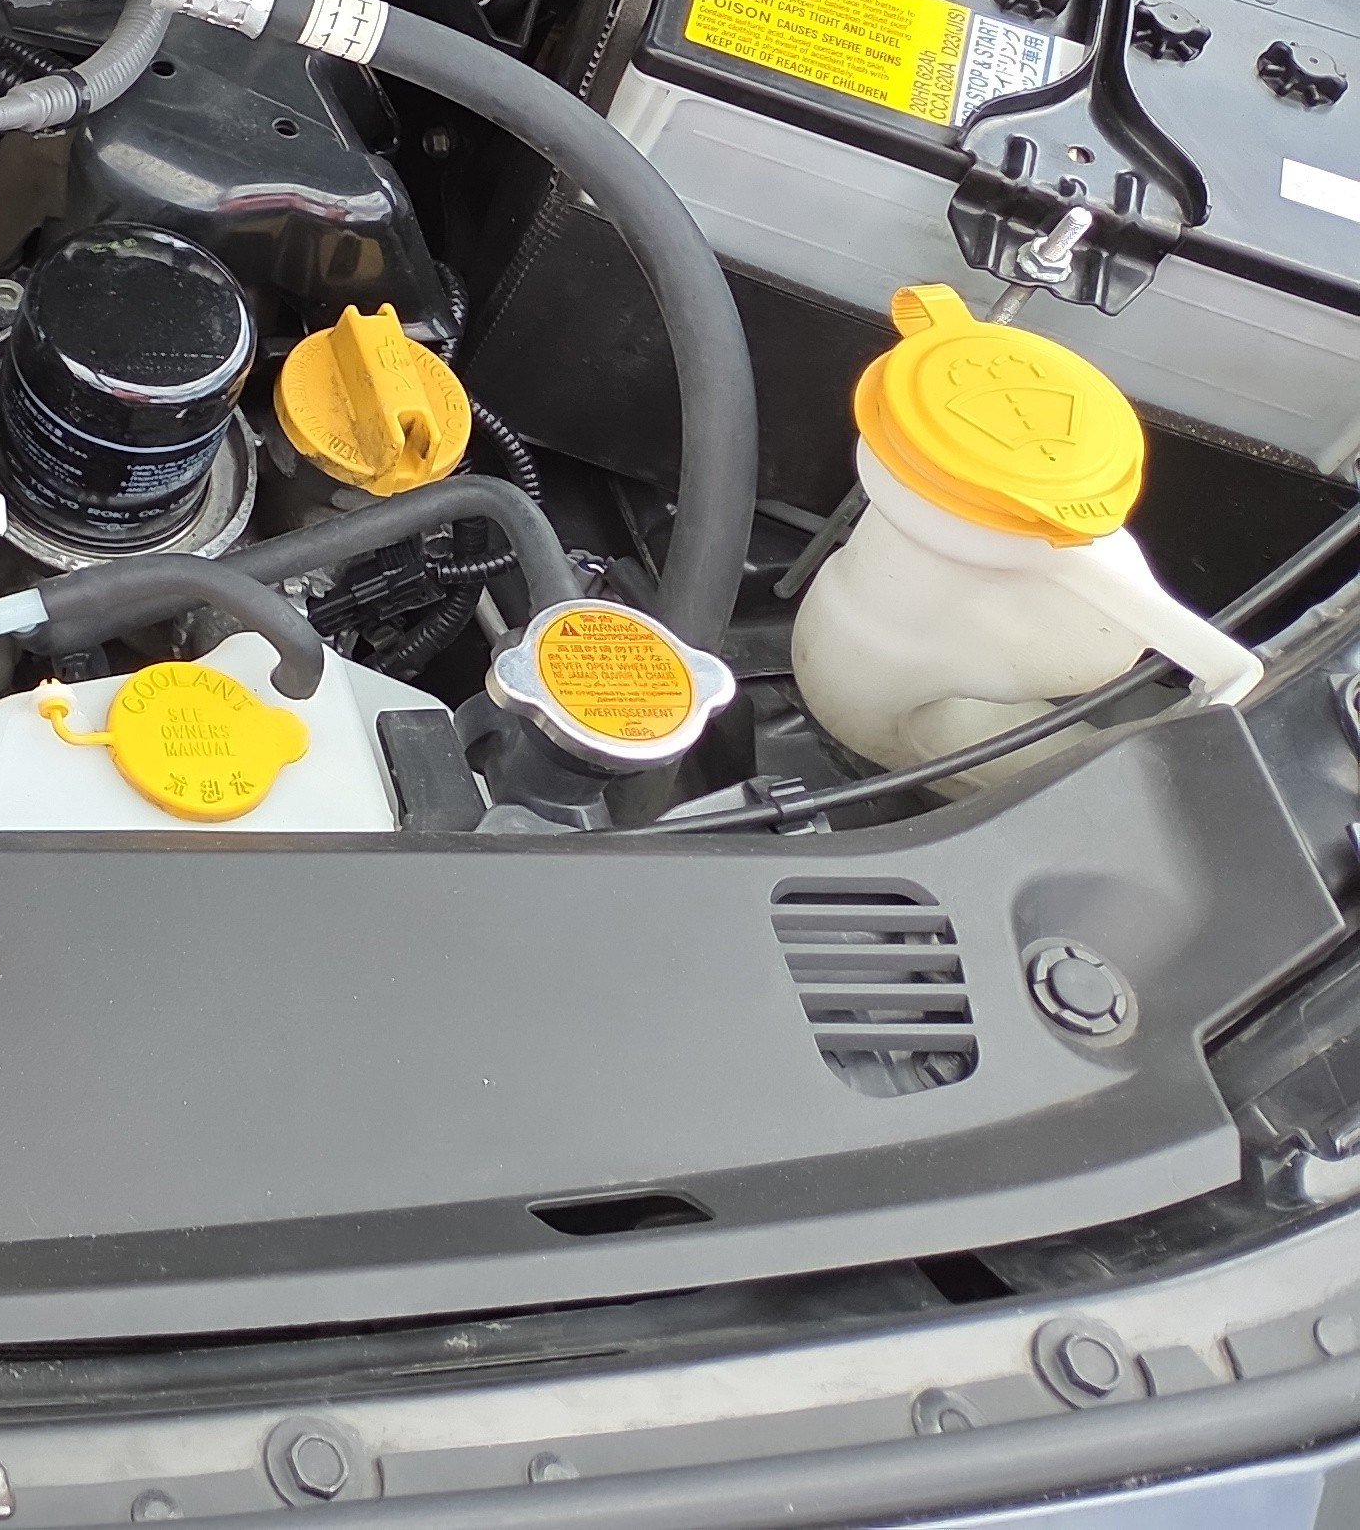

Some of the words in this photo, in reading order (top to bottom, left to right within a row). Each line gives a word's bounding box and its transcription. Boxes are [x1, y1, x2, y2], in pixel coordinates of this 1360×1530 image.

[777, 0, 805, 17] CAPS
[807, 10, 840, 29] TIGHT
[843, 22, 865, 37] AND
[868, 30, 901, 49] LEVEL
[974, 19, 999, 59] START
[776, 17, 818, 39] CAUSES
[821, 32, 861, 54] SEVERE
[865, 47, 902, 67] BURNS
[705, 32, 732, 49] KEEP
[734, 42, 756, 57] OUT
[758, 50, 772, 63] OF
[775, 56, 811, 76] REACH
[815, 70, 828, 82] OF
[831, 75, 887, 102] CHILDREN
[915, 50, 937, 81] 62Ah
[935, 62, 956, 92] 620A
[909, 80, 933, 115] 20HR
[965, 68, 990, 102] STOP
[929, 93, 951, 120] CCA
[30, 475, 80, 510] TOKYO
[87, 507, 130, 519] ROKI
[1055, 500, 1118, 520] PULL
[580, 623, 638, 633] WARNING
[550, 662, 582, 671] NEVER
[586, 663, 613, 671] OPEN
[618, 663, 647, 671] WHEN
[121, 667, 253, 714] COOLANT
[167, 707, 204, 723] SEE
[584, 708, 674, 718] AVERTISSEMENT
[163, 741, 237, 757] MANUAL
